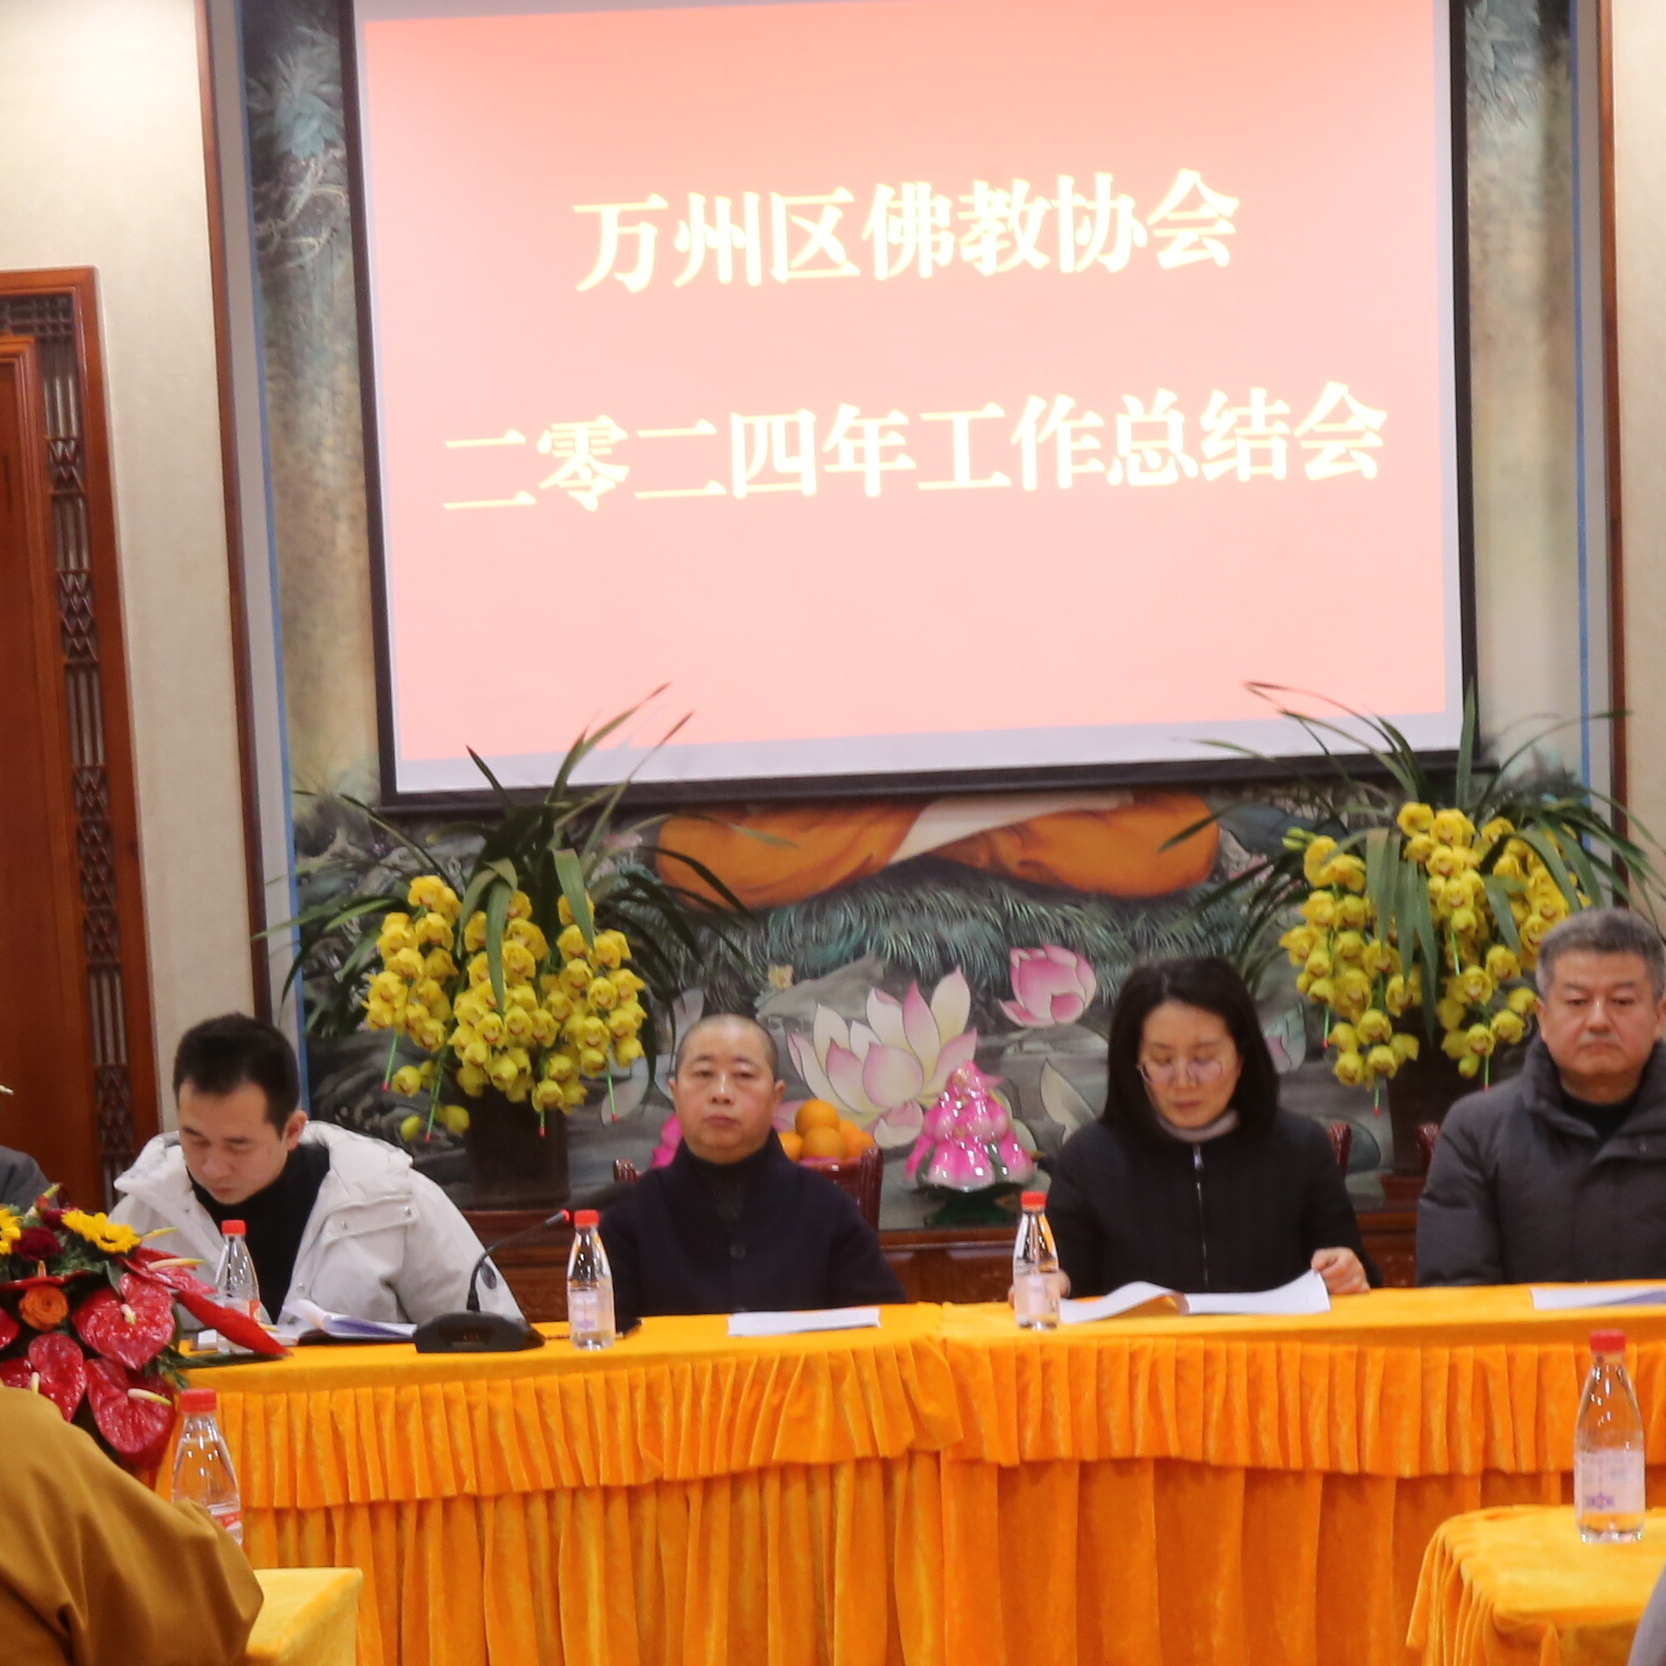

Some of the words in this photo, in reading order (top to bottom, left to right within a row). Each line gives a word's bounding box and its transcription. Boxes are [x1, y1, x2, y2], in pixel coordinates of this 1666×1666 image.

[572, 168, 1240, 292] 万州区佛教协会
[442, 381, 1388, 511] 二零二四年工作总结会
